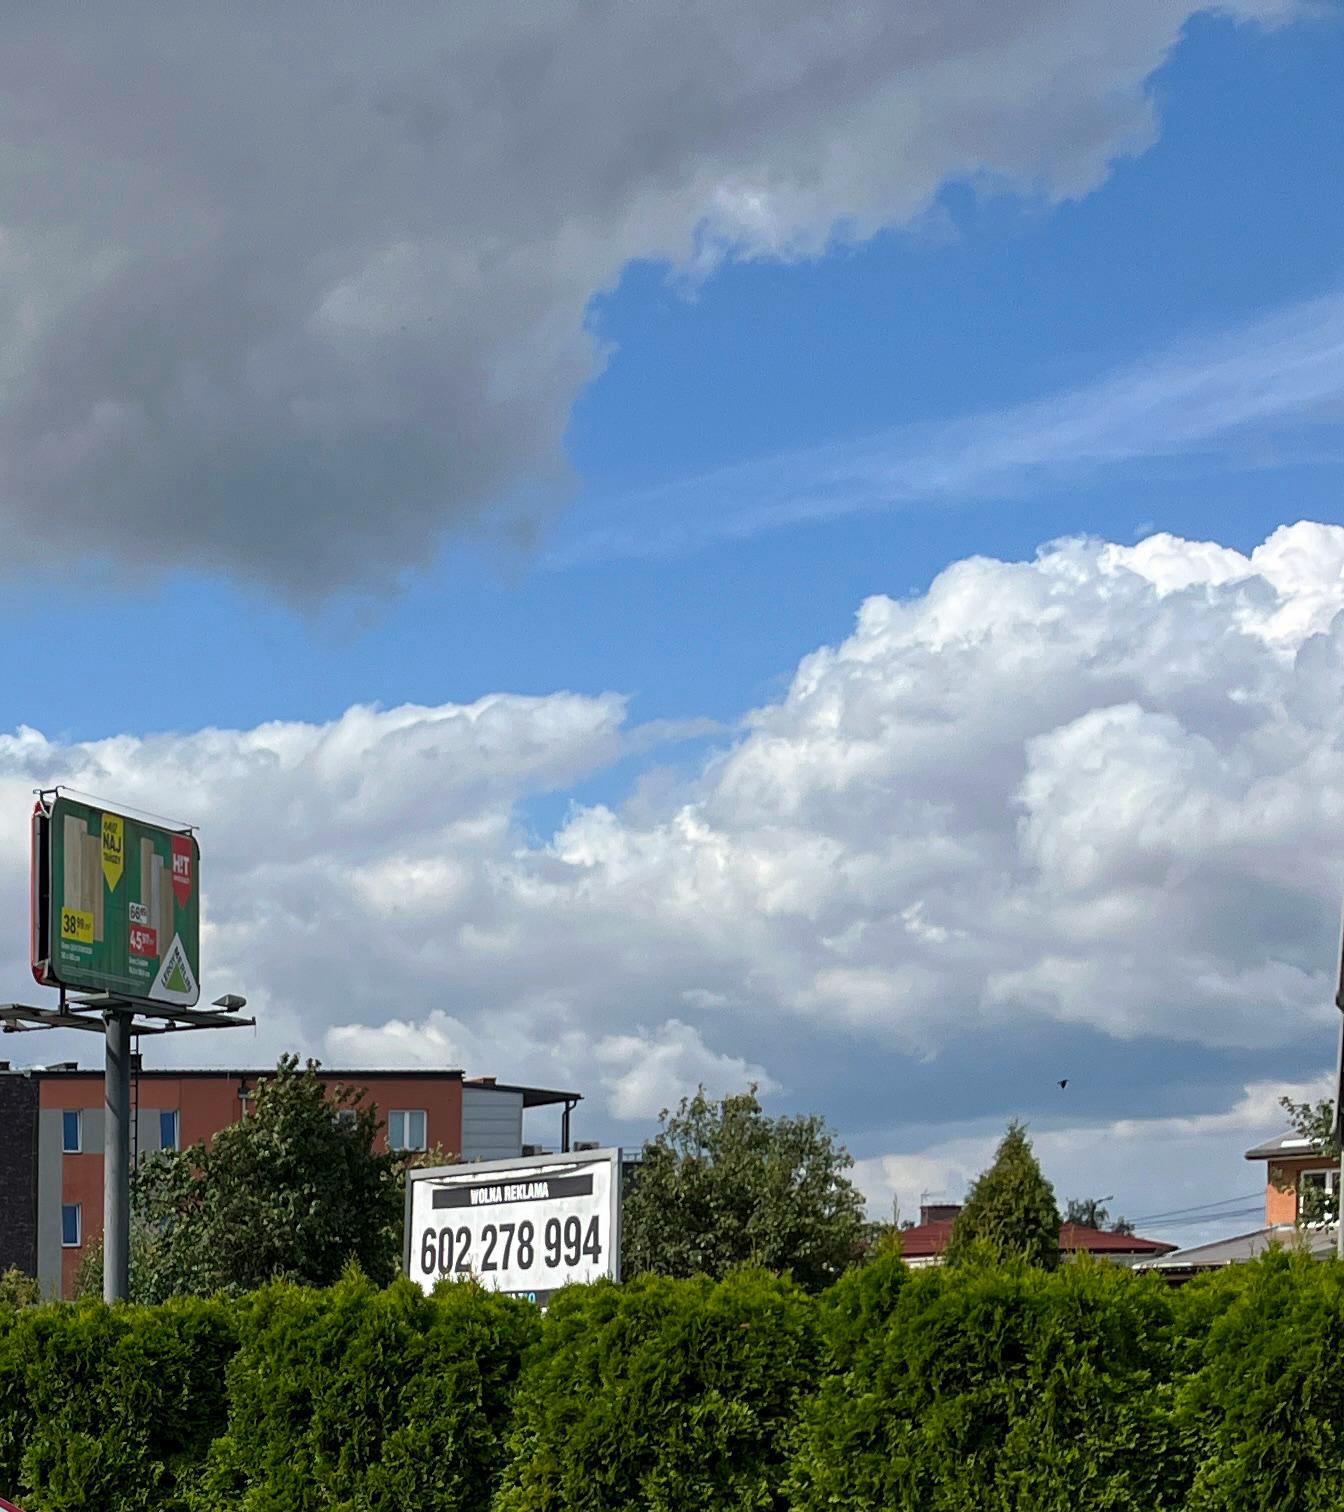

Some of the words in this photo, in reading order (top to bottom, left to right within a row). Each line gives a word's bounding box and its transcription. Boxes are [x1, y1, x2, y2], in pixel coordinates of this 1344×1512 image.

[470, 1187, 502, 1205] WOLNA
[504, 1181, 549, 1201] REKLAMA
[420, 1226, 472, 1275] 602
[480, 1219, 535, 1271] 278
[544, 1214, 602, 1269] 994
